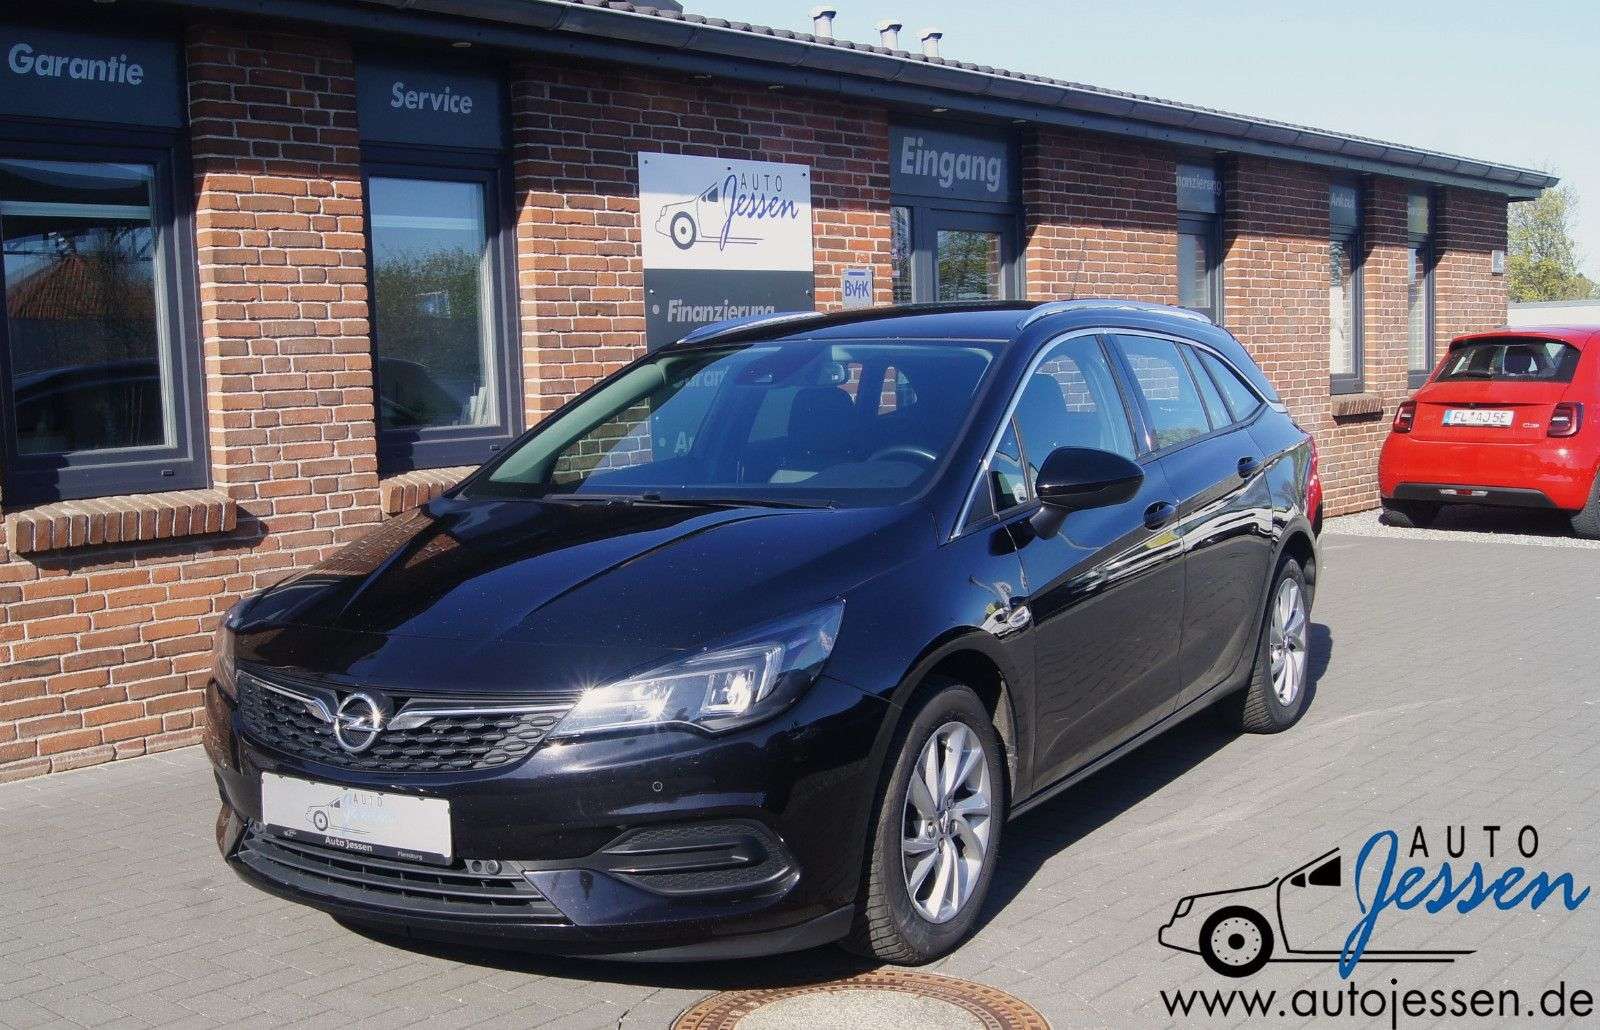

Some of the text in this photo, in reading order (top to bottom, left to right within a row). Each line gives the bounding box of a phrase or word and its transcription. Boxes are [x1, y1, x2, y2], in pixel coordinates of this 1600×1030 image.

[8, 43, 144, 85] Garantie
[390, 81, 473, 114] Service
[900, 136, 1002, 192] Eingang
[740, 172, 783, 192] AUTO
[719, 174, 799, 251] Jessen
[352, 793, 383, 808] AUTO
[325, 836, 373, 852] Auto Jessen
